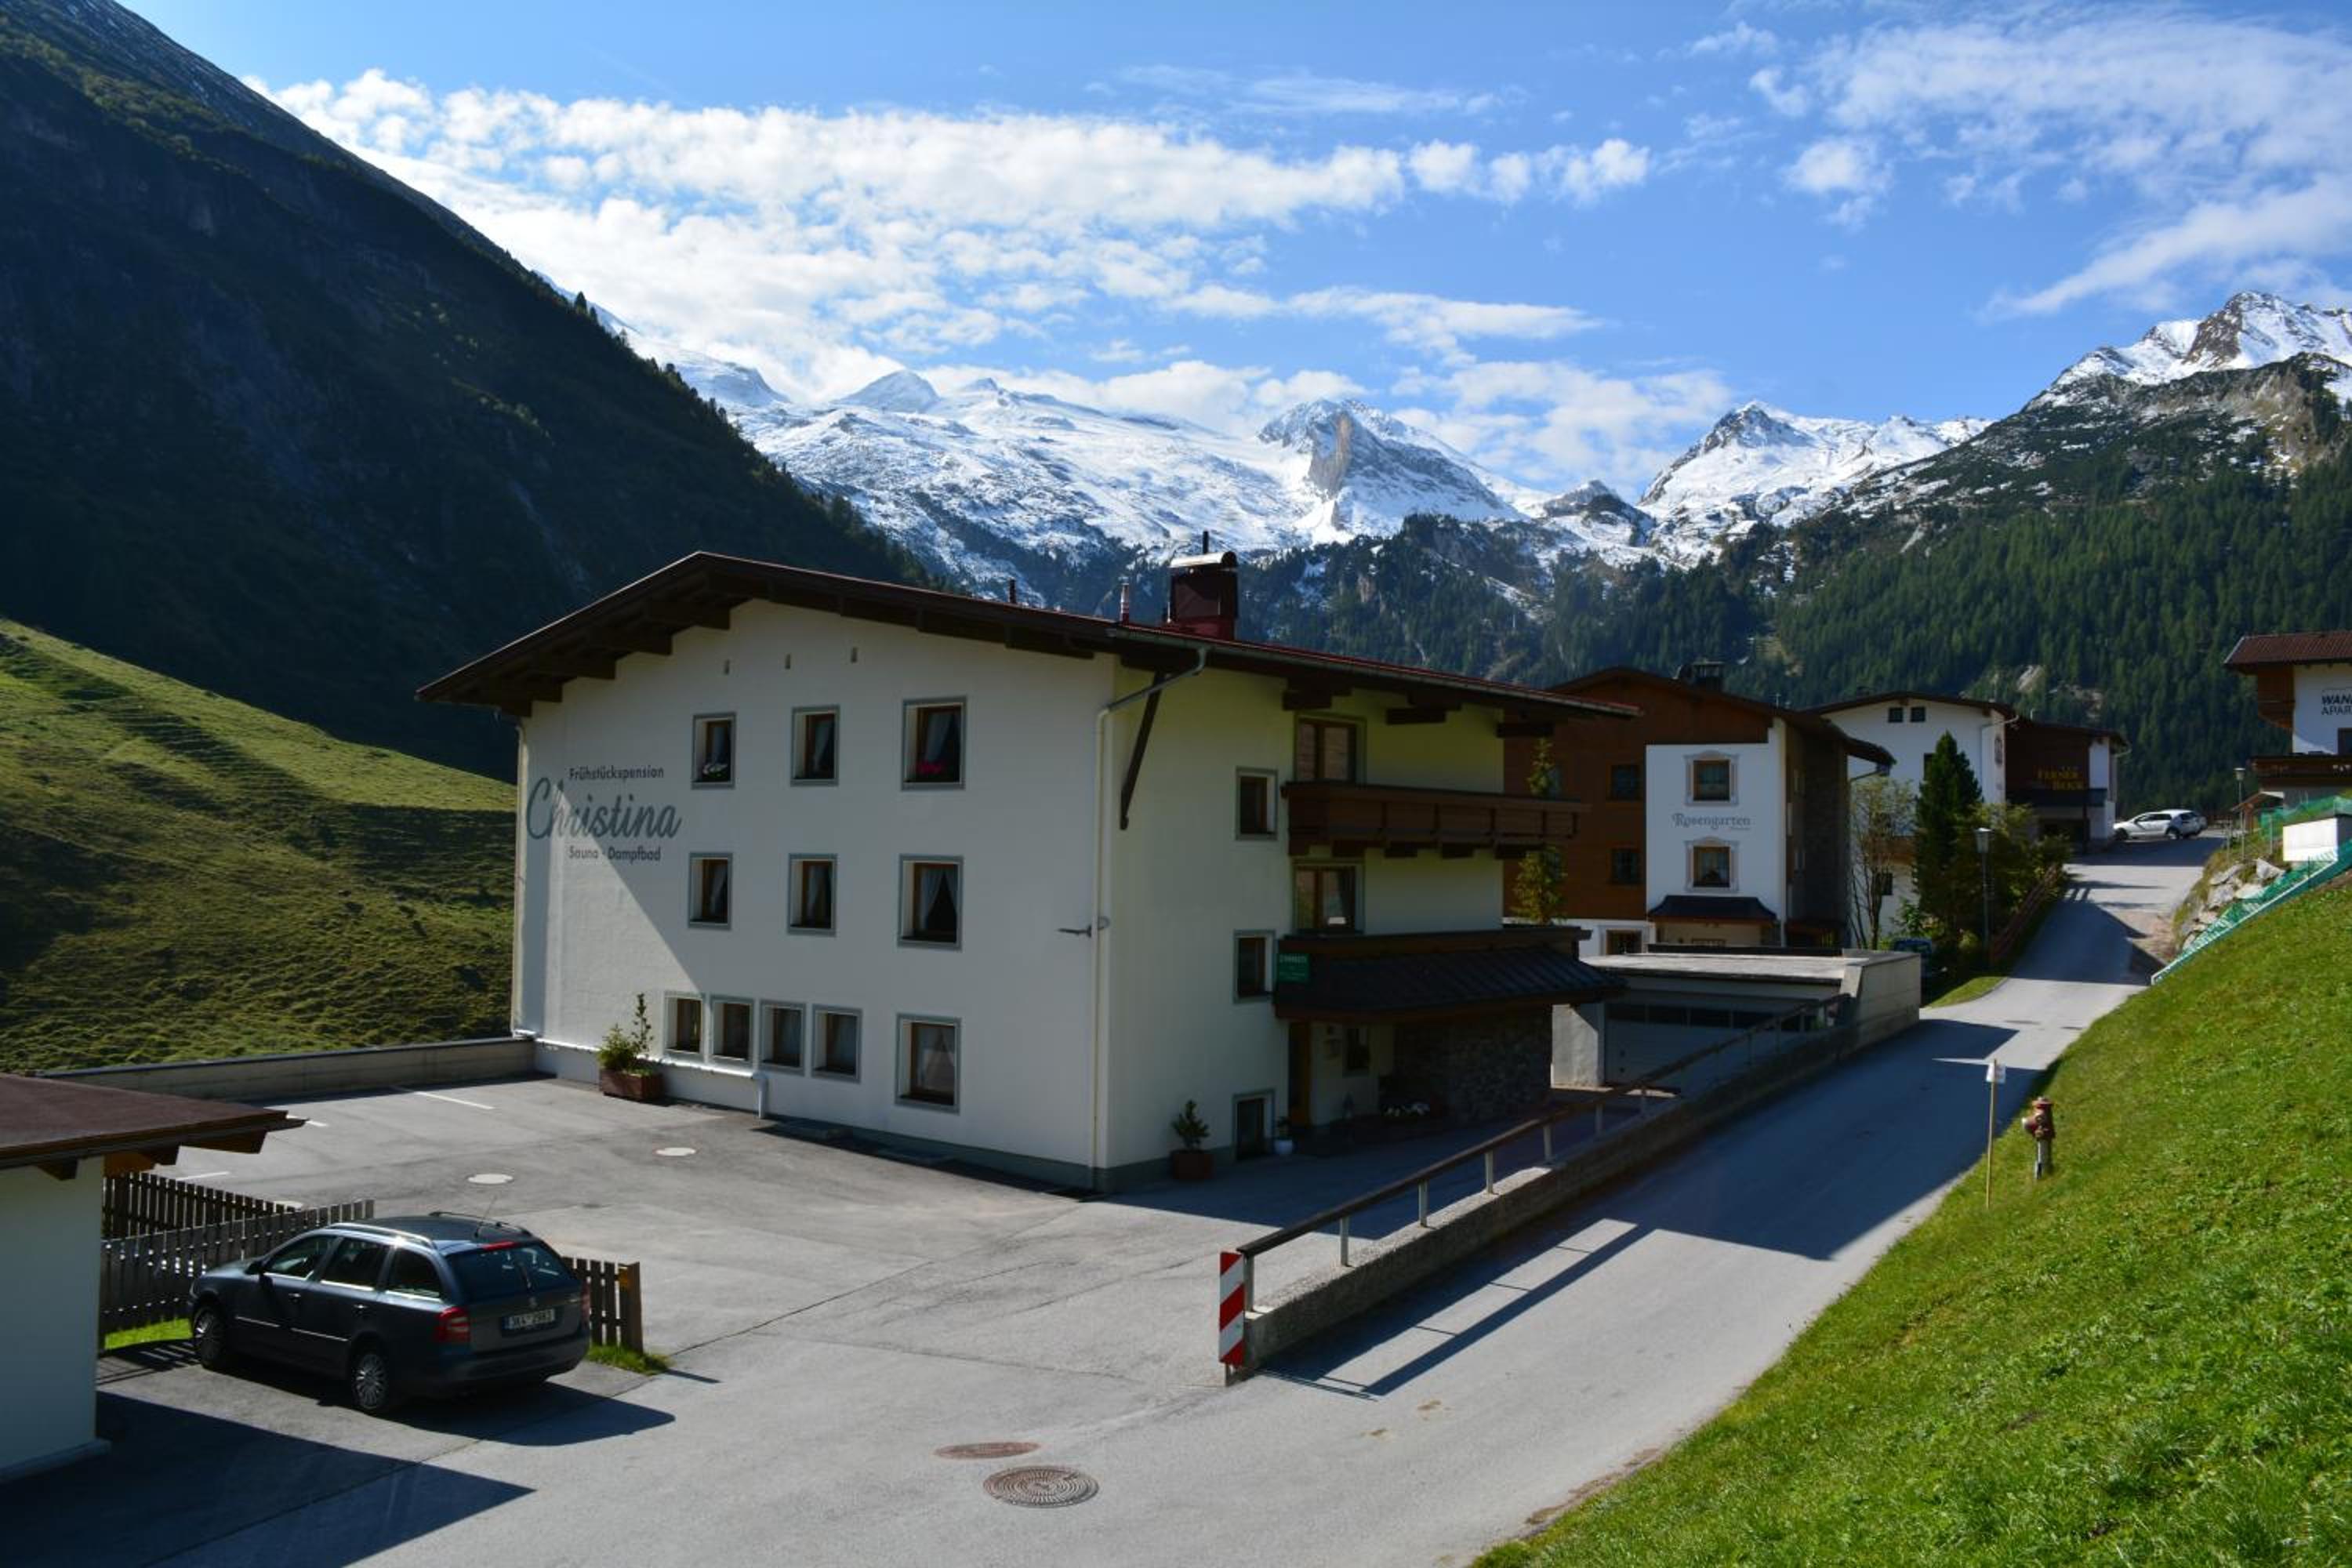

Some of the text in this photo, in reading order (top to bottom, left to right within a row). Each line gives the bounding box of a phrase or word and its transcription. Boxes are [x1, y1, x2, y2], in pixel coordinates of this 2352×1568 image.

[568, 765, 664, 782] Frühstückspension
[527, 777, 681, 838] Christina
[1671, 813, 1751, 829] Rosengarten
[569, 845, 662, 863] Sauna Dampfbad
